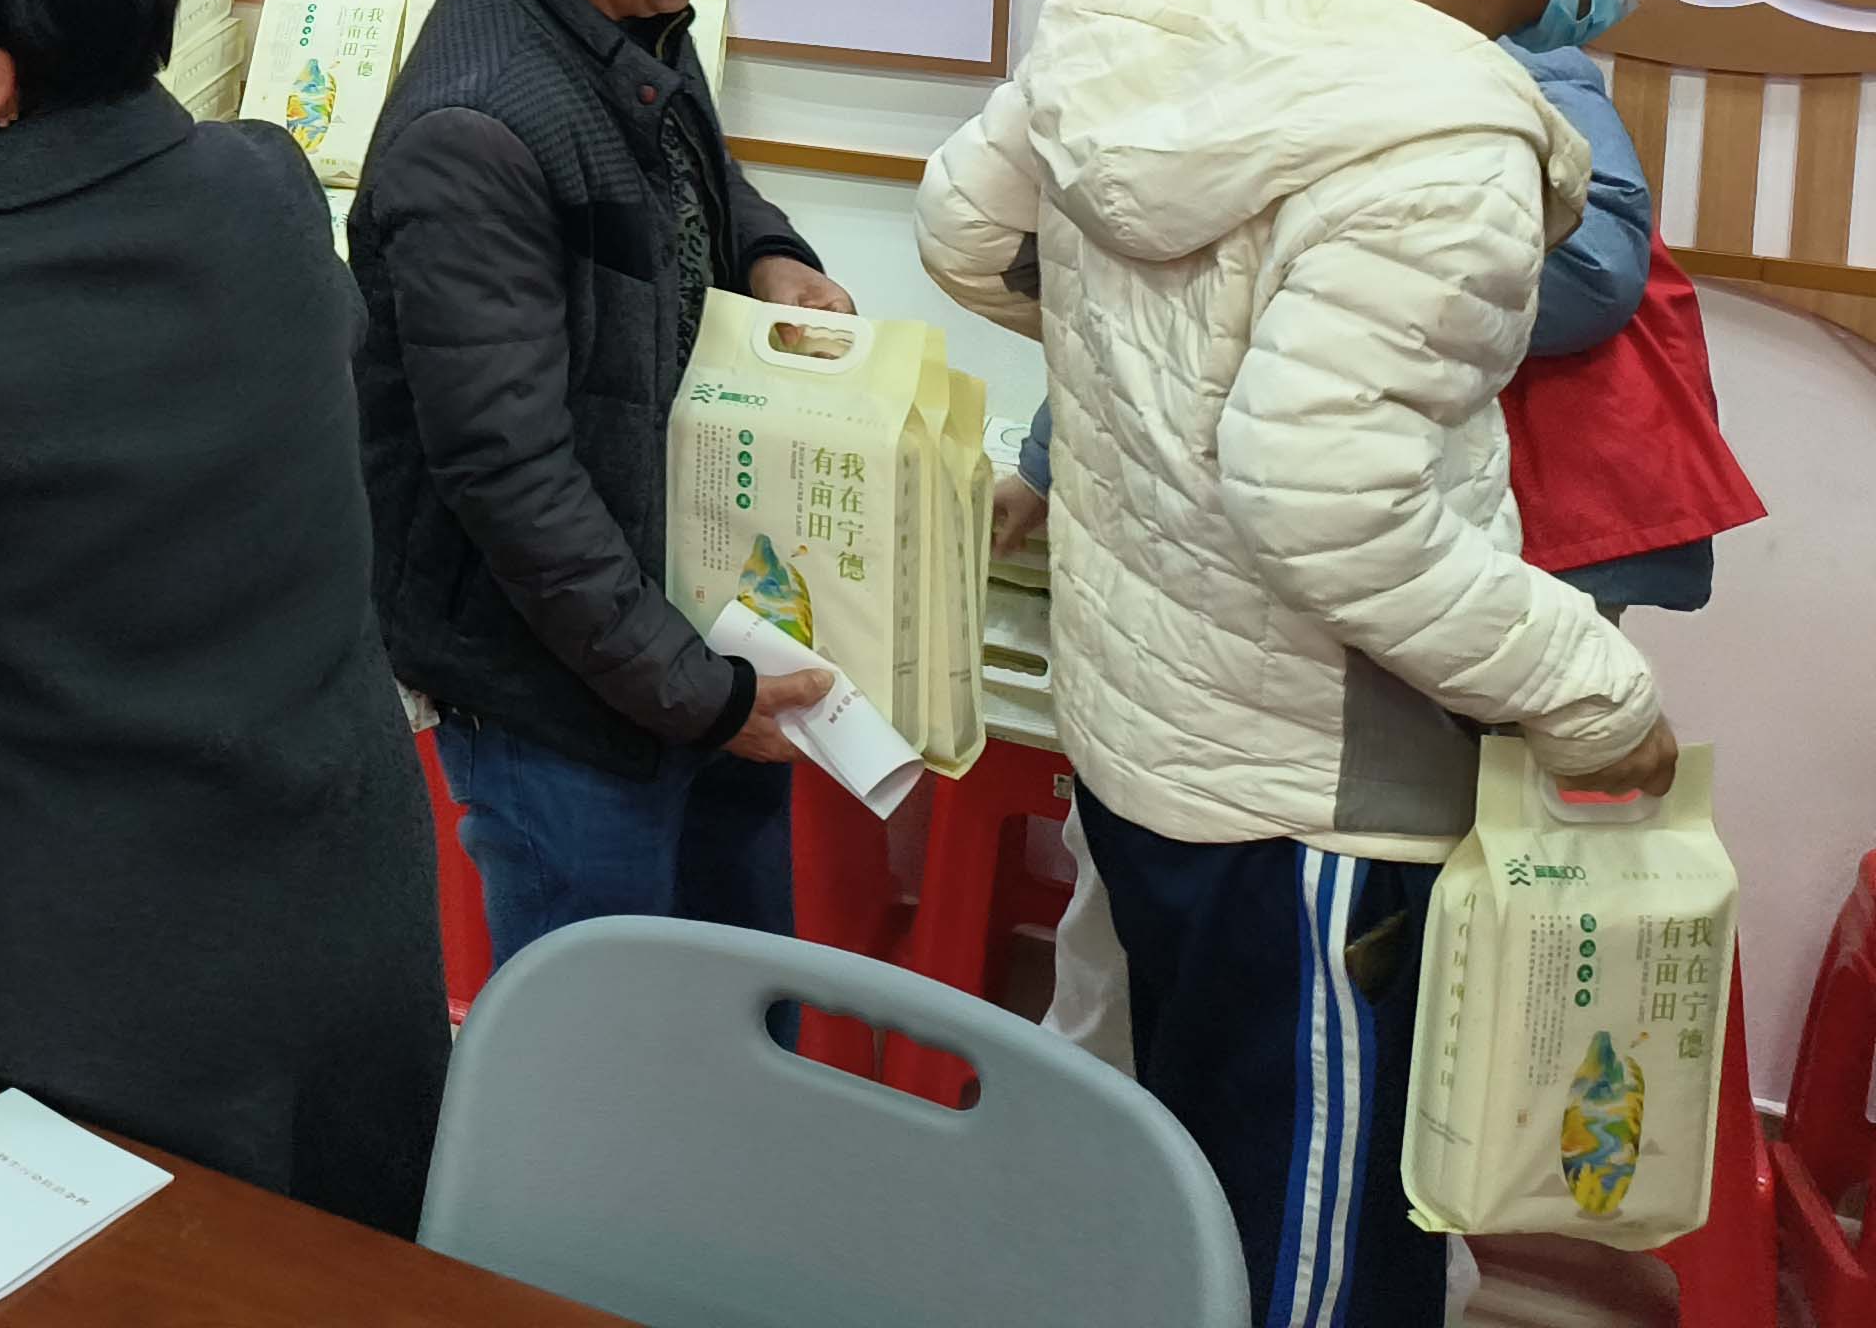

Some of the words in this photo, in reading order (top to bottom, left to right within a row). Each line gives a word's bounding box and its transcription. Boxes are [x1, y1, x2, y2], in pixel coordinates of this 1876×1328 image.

[808, 447, 836, 541] 有亩田
[836, 451, 866, 582] 我在宁德
[1651, 916, 1685, 1022] 有亩田
[1677, 916, 1713, 1059] 我在宁德
